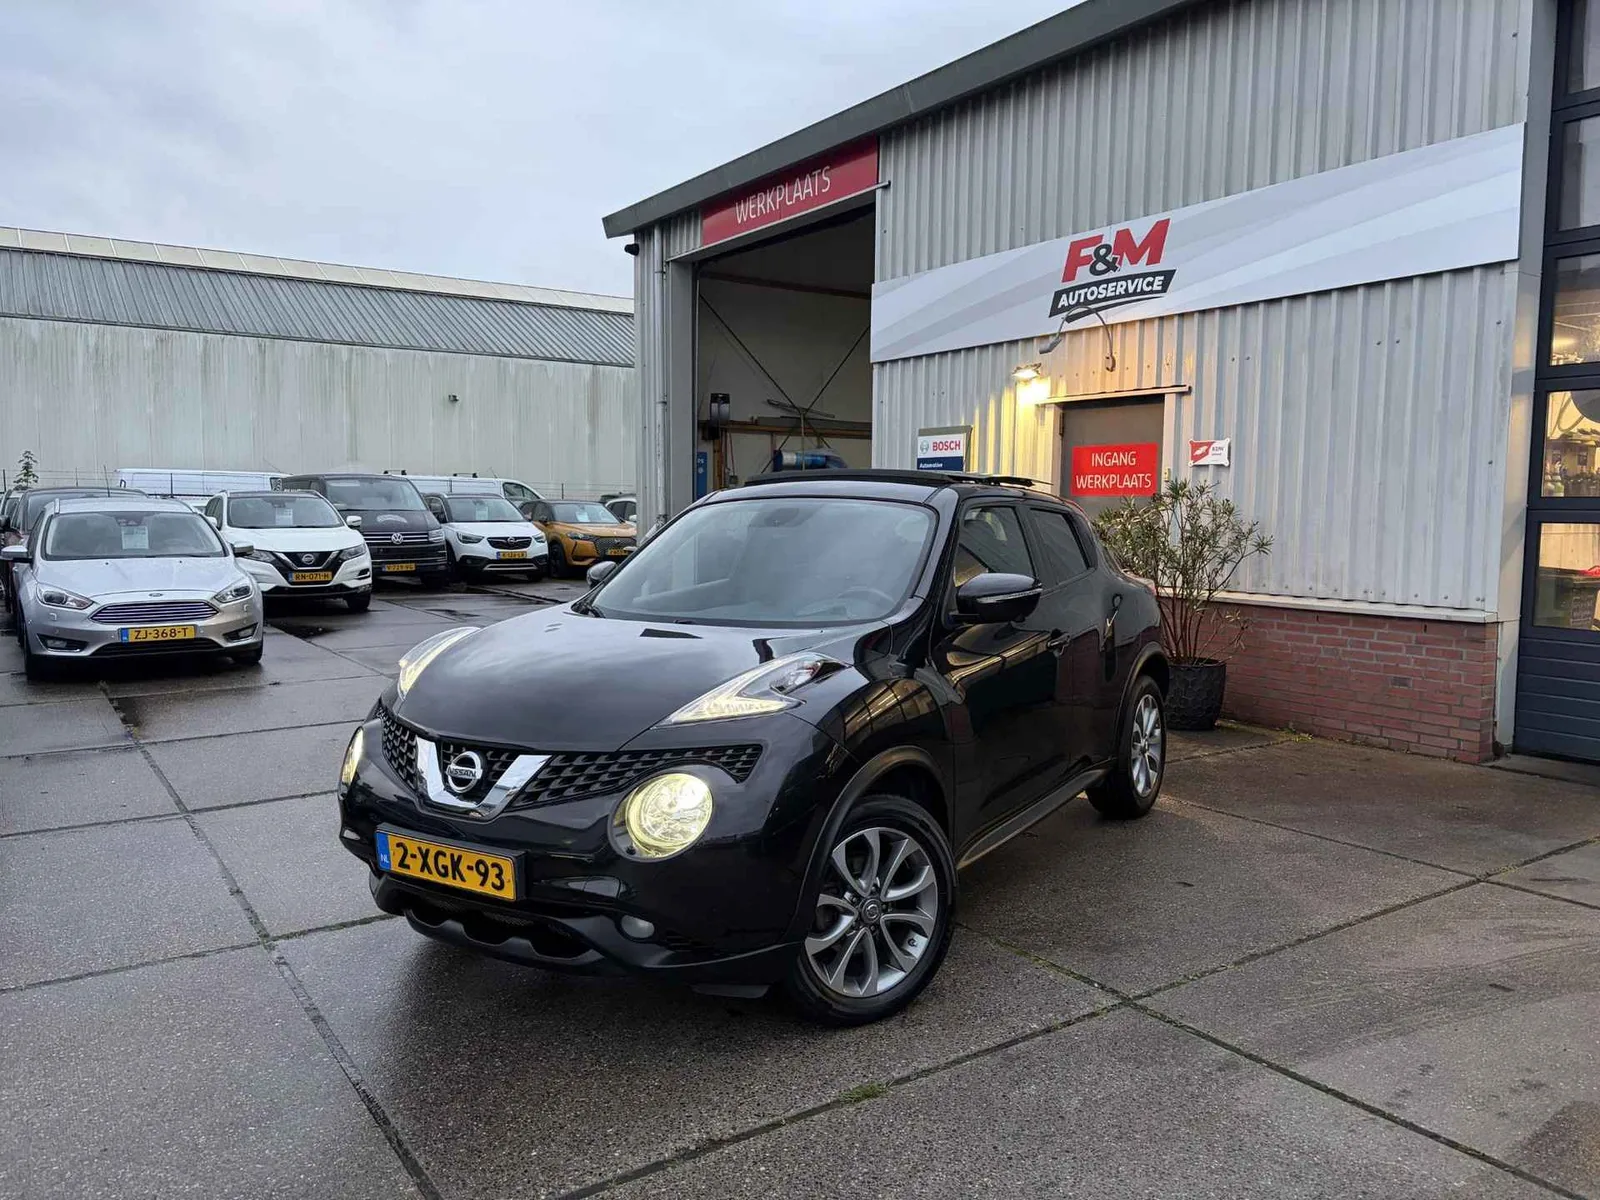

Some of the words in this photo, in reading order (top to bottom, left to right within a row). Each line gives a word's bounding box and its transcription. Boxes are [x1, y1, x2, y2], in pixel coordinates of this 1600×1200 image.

[735, 165, 831, 224] WERKPLAATS
[1061, 218, 1170, 283] F&M
[1057, 276, 1164, 308] AUTOSERVICE
[932, 441, 961, 451] BOSCH
[1091, 451, 1137, 467] INGANG
[1076, 473, 1152, 489] WERKPLAATS
[295, 572, 329, 580] RN-071-H
[134, 627, 189, 640] ZJ-368-T
[448, 766, 477, 778] NISSAN
[380, 854, 390, 864] NL
[395, 842, 505, 891] 2-XGK-93
